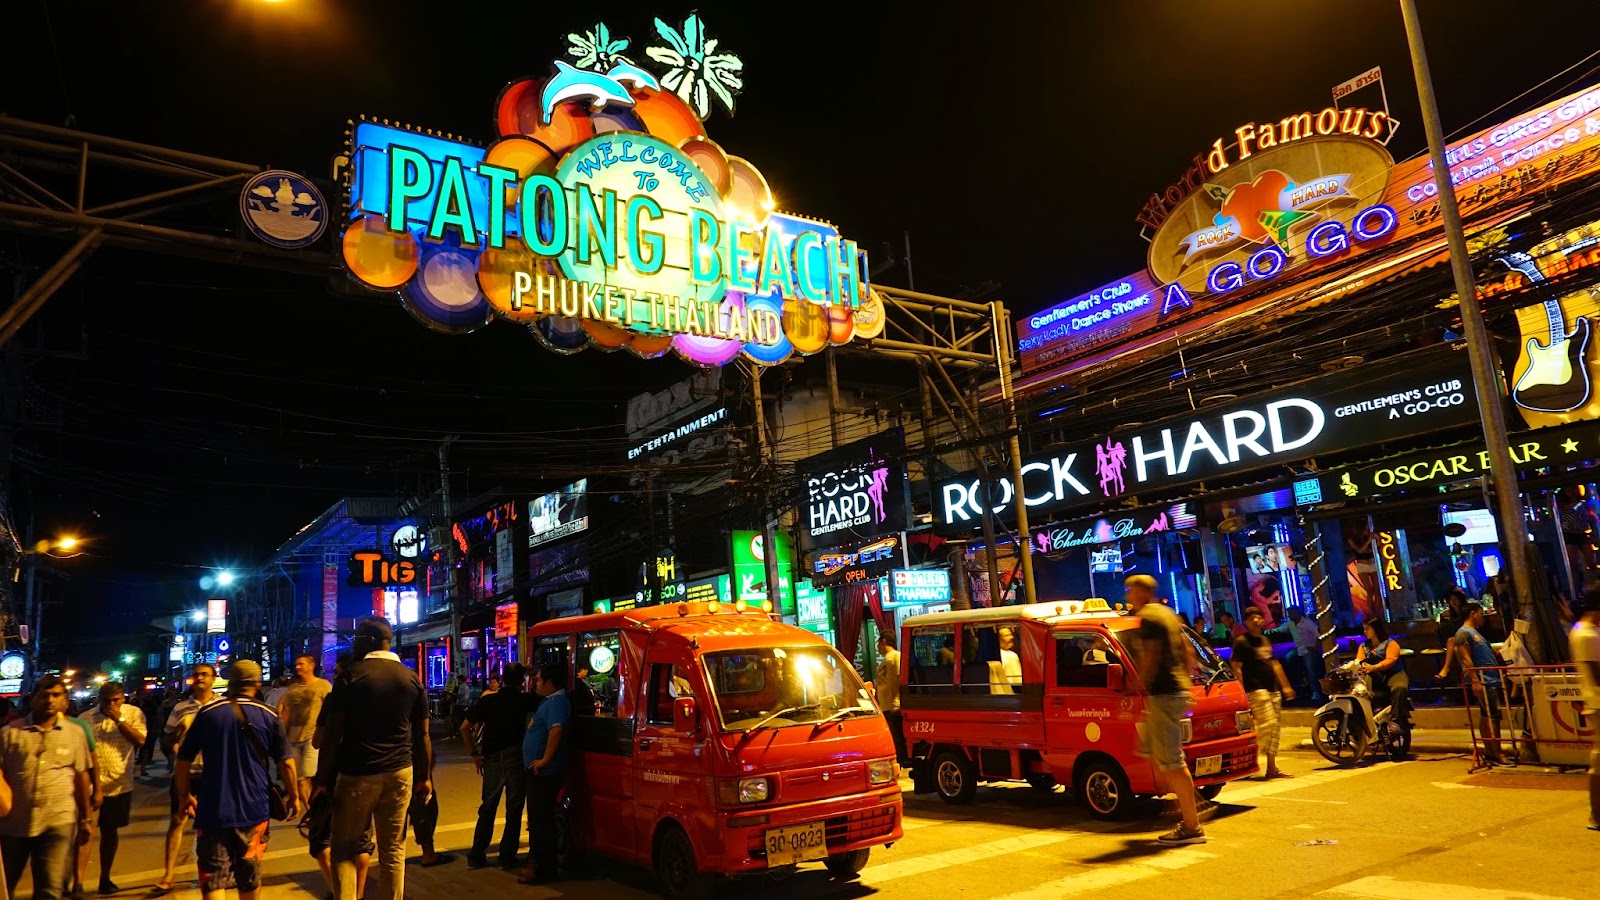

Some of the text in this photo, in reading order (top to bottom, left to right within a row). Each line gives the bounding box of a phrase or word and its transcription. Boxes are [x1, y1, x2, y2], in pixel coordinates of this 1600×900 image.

[1429, 138, 1487, 172] IRLS
[1490, 109, 1553, 150] GIRLS
[576, 140, 709, 203] WELCOME
[1136, 105, 1388, 230] World Famous
[1407, 155, 1500, 202] Coktail,
[1501, 127, 1581, 167] Dance
[1291, 179, 1340, 208] HARD
[386, 143, 862, 310] PATONG BEACH
[1196, 223, 1236, 248] ROCK
[1162, 204, 1398, 316] A GO GO
[1101, 282, 1133, 301] Club
[510, 270, 782, 346] PHUKET THAILAND
[1071, 308, 1112, 331] Dance
[1111, 293, 1150, 316] Shows
[1334, 379, 1462, 418] GENTLEMEN'S CLUB
[1388, 393, 1465, 420] A GO-GO
[942, 398, 1325, 525] ROCK HARD
[1374, 455, 1474, 488] OSCAR
[1295, 480, 1318, 492] BEER
[1297, 493, 1319, 503] ZERO
[809, 491, 870, 529] HARD
[810, 514, 871, 537] GENTLEMEN'S CLUB
[1113, 518, 1144, 540] Bar
[814, 546, 894, 573] ENTER
[845, 569, 866, 583] OPEN
[896, 588, 949, 601] PHARMACY
[769, 829, 823, 854] 30-0823
